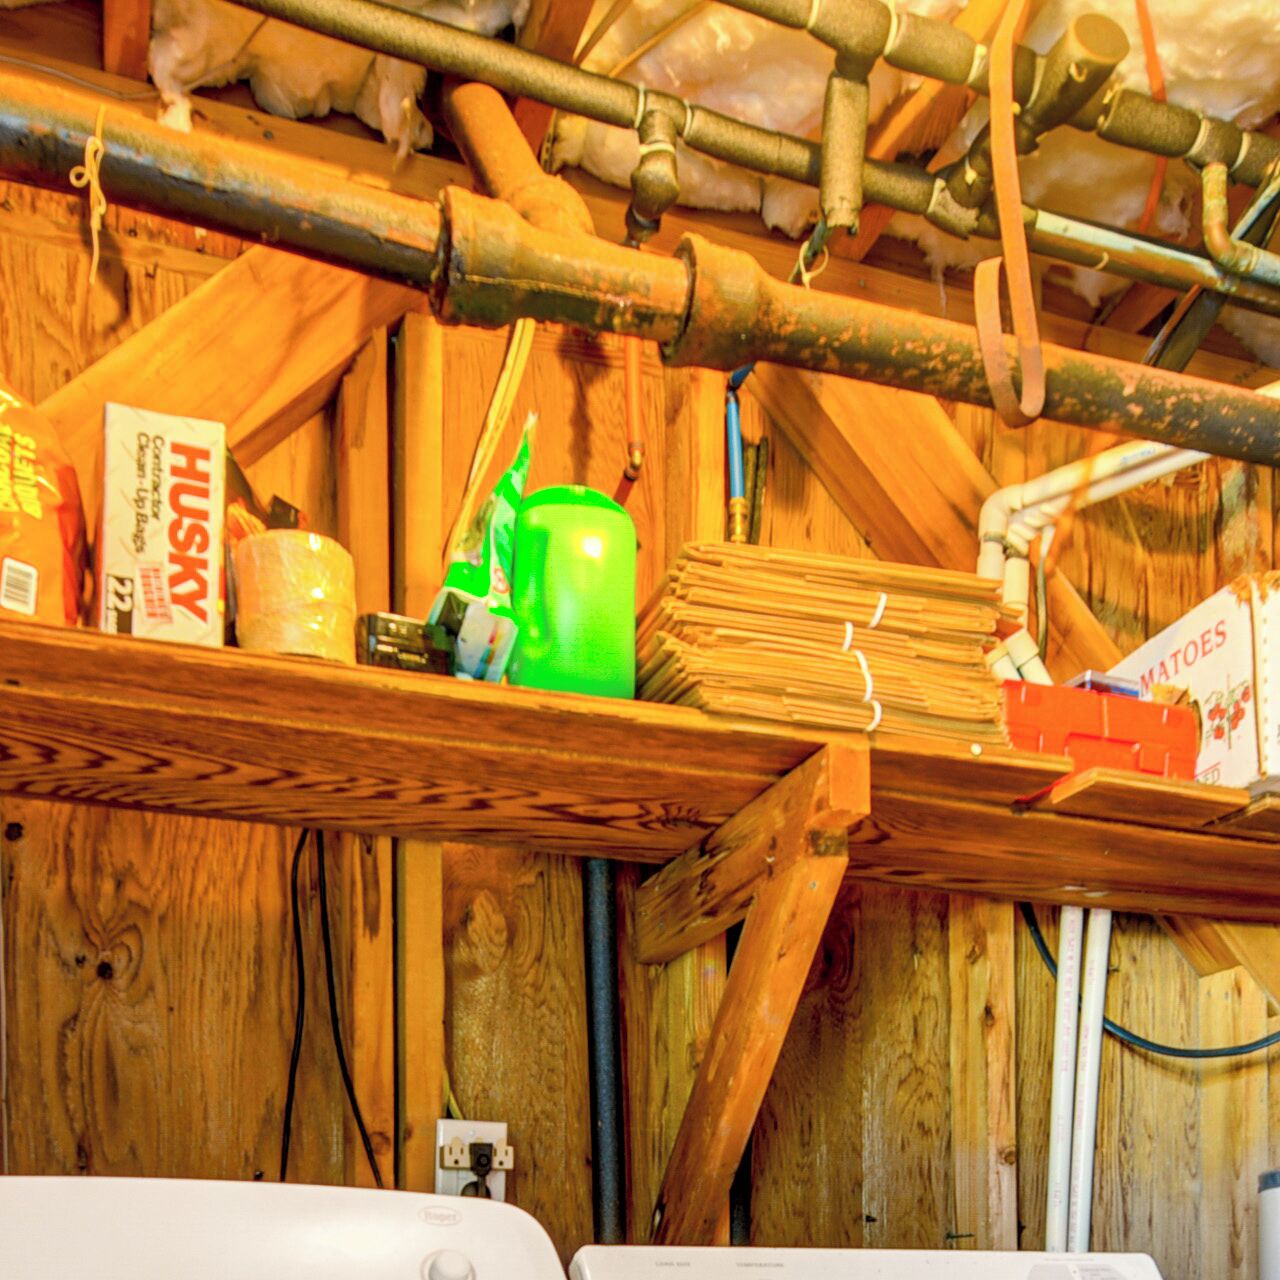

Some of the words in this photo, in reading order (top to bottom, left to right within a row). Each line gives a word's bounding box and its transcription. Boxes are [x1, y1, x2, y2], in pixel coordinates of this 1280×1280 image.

[152, 435, 165, 520] Contractor
[133, 511, 149, 553] Bags
[168, 441, 211, 624] HUSKY
[107, 574, 133, 612] 22
[1140, 620, 1228, 697] MATOES
